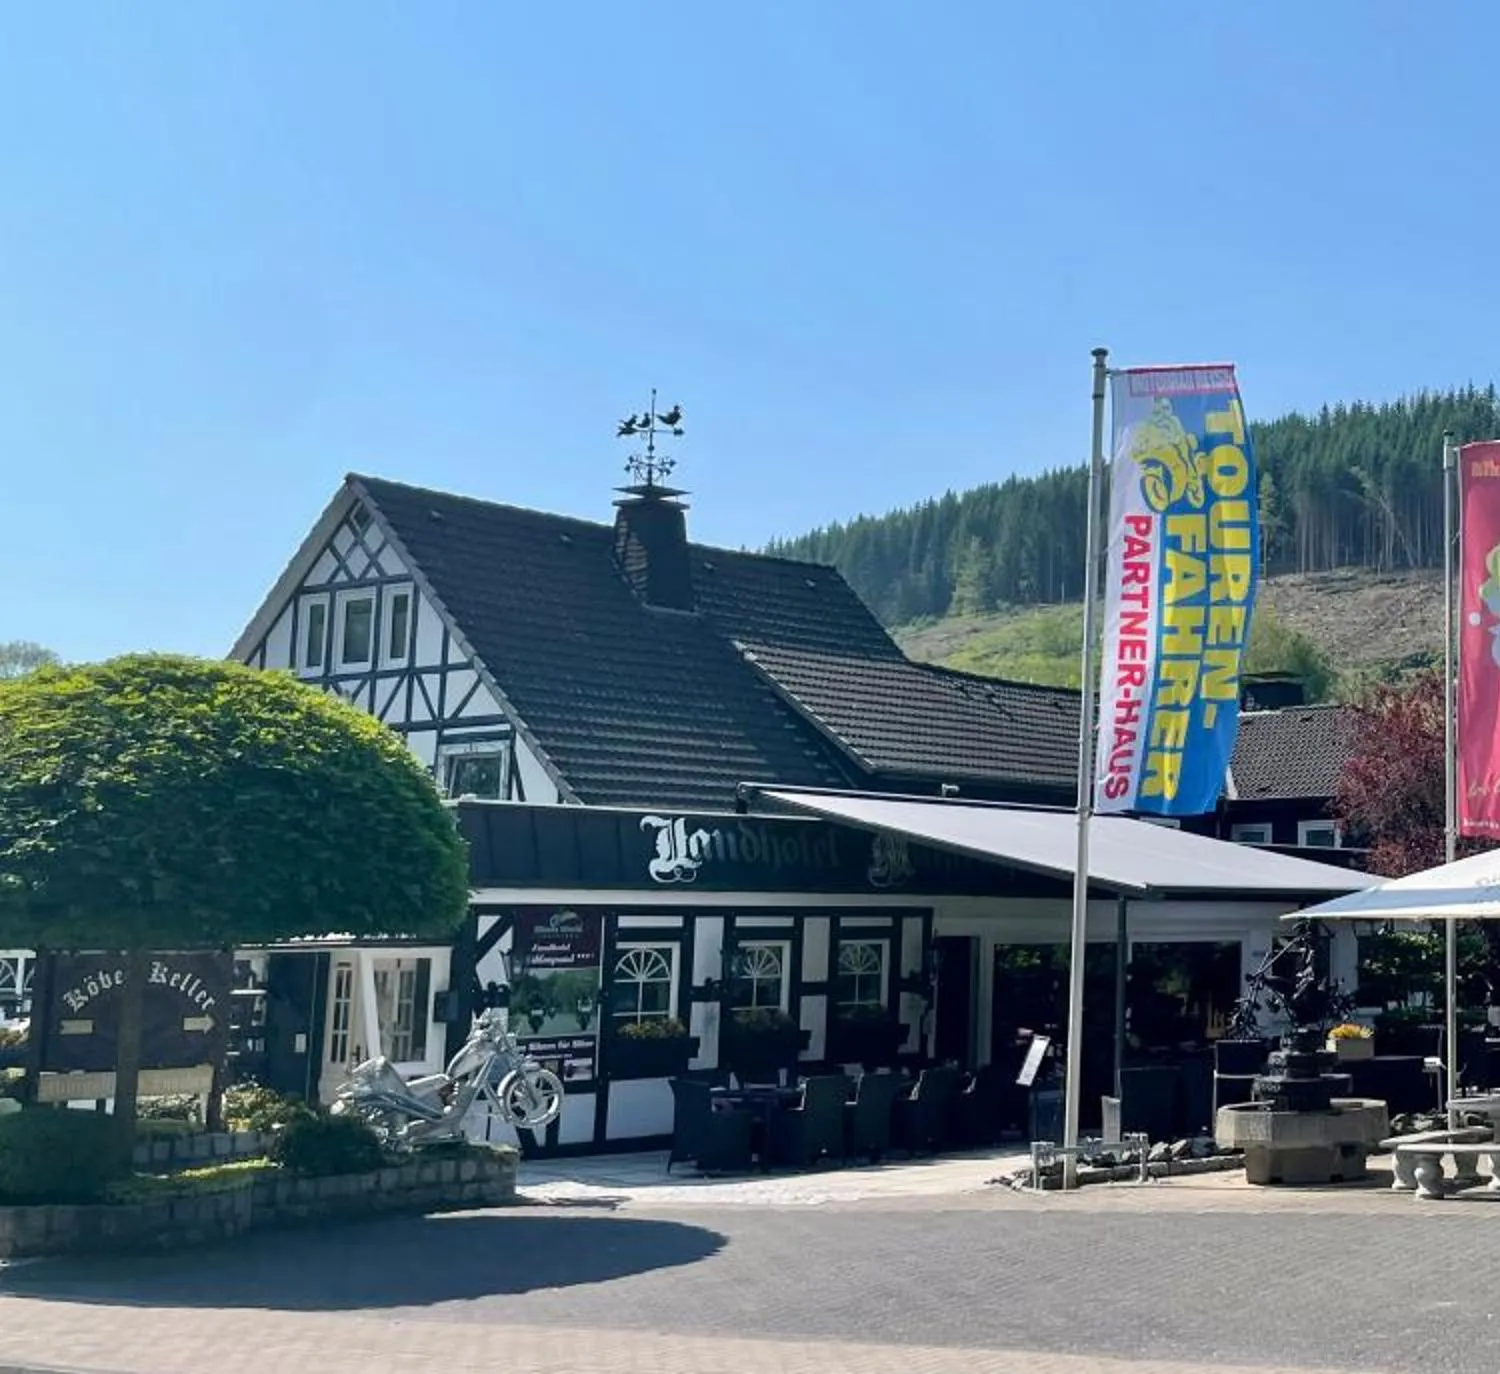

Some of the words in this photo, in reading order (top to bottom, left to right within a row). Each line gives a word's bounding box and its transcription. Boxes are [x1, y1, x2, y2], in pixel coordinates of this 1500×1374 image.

[1104, 515, 1153, 800] PARTNER-HAUS
[1140, 514, 1207, 800] FAHRER
[1203, 398, 1251, 729] TOUREN-
[148, 961, 216, 1011] Keller
[640, 815, 842, 884] Landhotel
